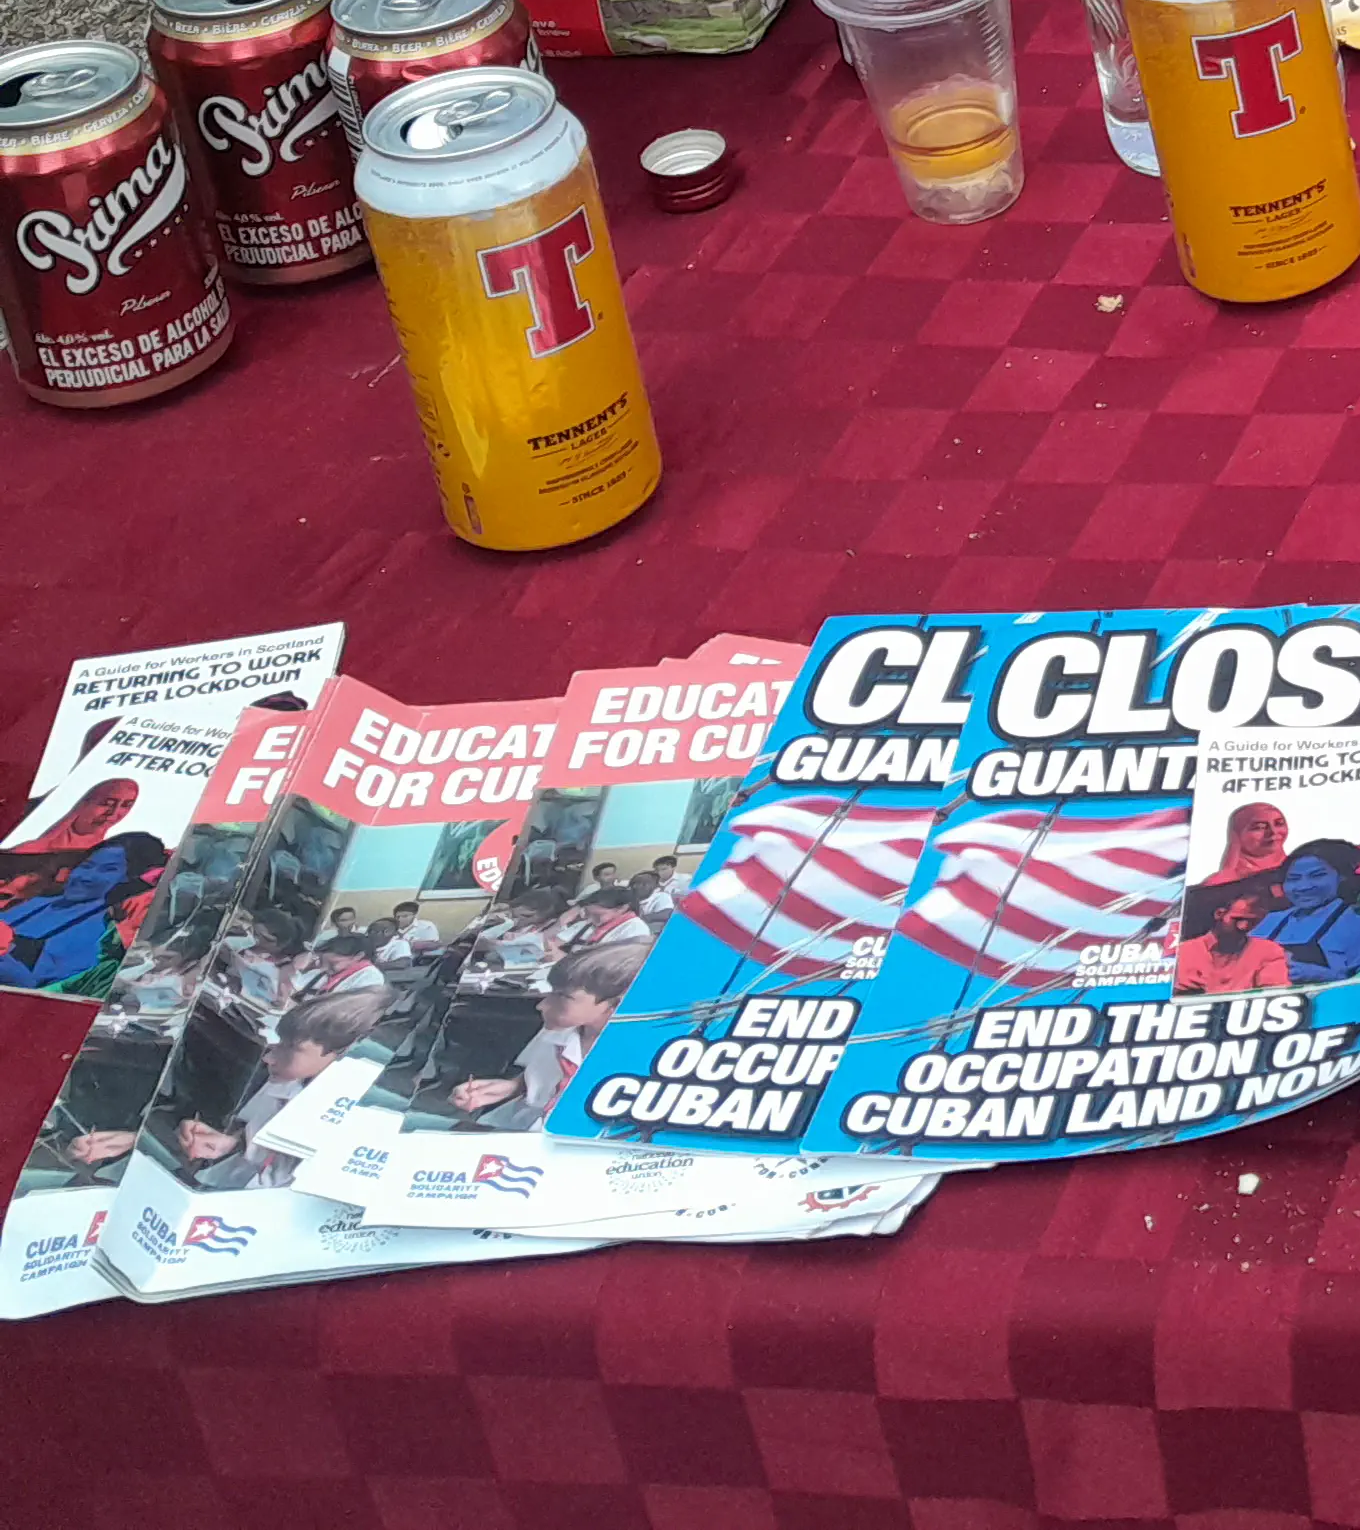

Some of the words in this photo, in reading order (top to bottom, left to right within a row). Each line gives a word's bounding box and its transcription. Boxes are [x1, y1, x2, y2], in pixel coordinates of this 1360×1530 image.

[1192, 9, 1303, 141] T
[289, 178, 341, 202] Pilsener
[1228, 178, 1328, 218] TENNENT'S
[17, 133, 178, 294] Prima
[238, 220, 305, 246] EXCESO
[310, 214, 332, 237] DE
[1265, 207, 1301, 224] LAGER
[223, 241, 320, 267] PERJUDICIAL
[320, 226, 363, 258] PARA
[476, 204, 596, 360] T
[119, 289, 172, 317] Pilsener
[62, 340, 135, 369] EXCESO
[139, 331, 165, 356] DE
[165, 288, 221, 345] ALCOHOL
[45, 358, 150, 390] PERJUDICIAL
[152, 337, 196, 373] PARA
[193, 325, 212, 351] LA
[526, 390, 628, 452] TENNENT'S
[571, 426, 608, 451] LAGER
[72, 665, 200, 697] RETURNING
[209, 660, 242, 678] TO
[248, 647, 322, 671] WORK
[79, 668, 90, 679] A
[93, 661, 140, 677] Guide
[144, 657, 167, 671] for
[170, 649, 235, 668] Workers
[239, 646, 252, 657] in
[256, 635, 325, 654] Scotland
[84, 689, 158, 713] AFTER
[164, 667, 301, 702] LOCKDOWN
[126, 716, 137, 726] A
[140, 717, 181, 734] Guide
[183, 724, 202, 736] for
[350, 707, 558, 766] EDUCAT
[107, 730, 223, 759] RETURNING
[567, 727, 686, 771] FOR
[1209, 740, 1220, 751] A
[1224, 738, 1268, 752] Guide
[1272, 737, 1293, 752] for
[1297, 735, 1359, 751] Workers
[106, 751, 172, 775] AFTER
[323, 747, 434, 809] FOR
[1206, 754, 1329, 773] RETURNING
[1221, 776, 1292, 794] AFTER
[1075, 960, 1176, 978] SOLIDARITY
[1079, 943, 1166, 964] CUBA
[1072, 972, 1173, 990] CAMPAIGN
[732, 997, 855, 1040] END
[977, 1007, 1094, 1050] END
[1106, 1000, 1207, 1041] THE
[1225, 996, 1301, 1034] US
[903, 1033, 1268, 1095] OCCUPATION
[1273, 1023, 1348, 1070] OF
[591, 1076, 804, 1133] CUBAN
[846, 1088, 1056, 1139] CUBAN
[1065, 1079, 1223, 1135] LAND
[412, 1169, 468, 1185] CUBA
[605, 1156, 694, 1176] education
[406, 1191, 478, 1201] CAMPAIGN
[410, 1183, 480, 1193] SOLIDARITY
[136, 1222, 190, 1257] SOLIDARITY
[141, 1206, 179, 1247] CUBA
[22, 1248, 92, 1272] SOLIDARITY
[25, 1233, 79, 1259] CUBA
[130, 1231, 188, 1265] CAMPAIGN
[19, 1259, 88, 1283] CAMPAIGN
